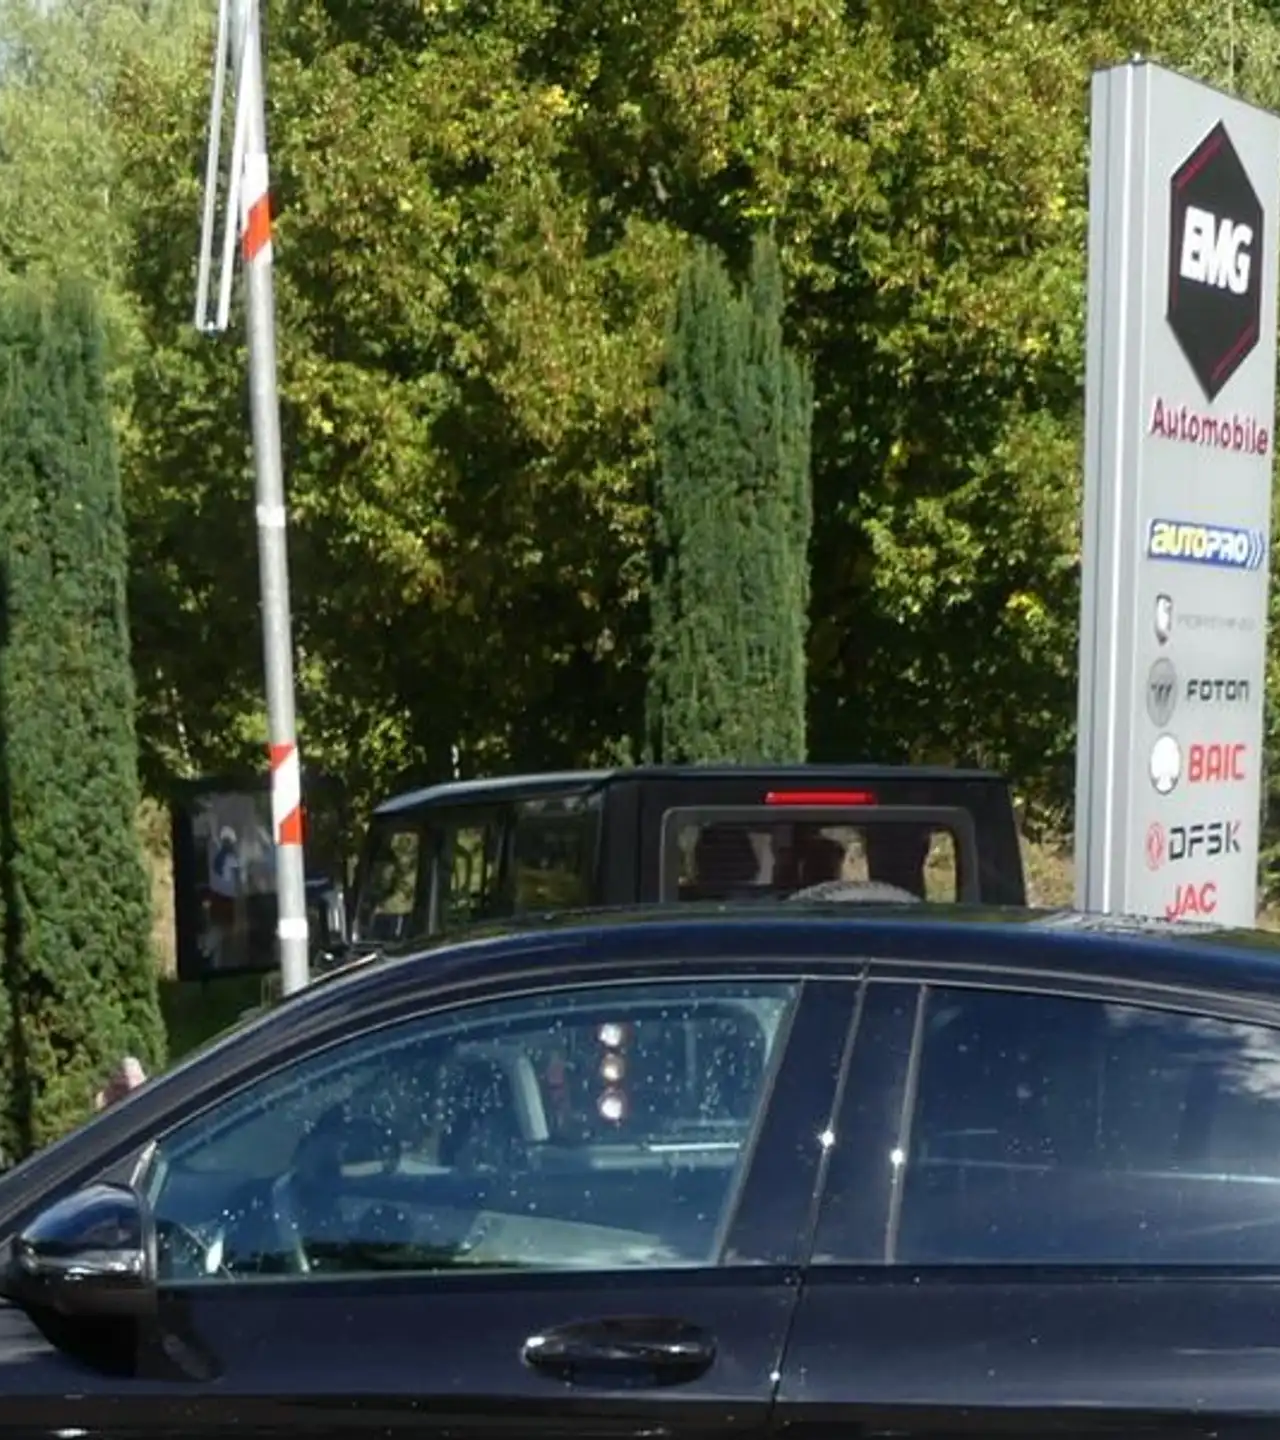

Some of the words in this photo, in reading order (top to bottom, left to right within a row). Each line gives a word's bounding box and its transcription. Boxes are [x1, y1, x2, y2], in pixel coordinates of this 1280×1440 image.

[1150, 396, 1268, 455] Automobile
[1186, 679, 1249, 702] FOTON
[1189, 743, 1245, 781] BAIC
[1168, 821, 1241, 861] DFSK
[1166, 882, 1217, 919] JAC
